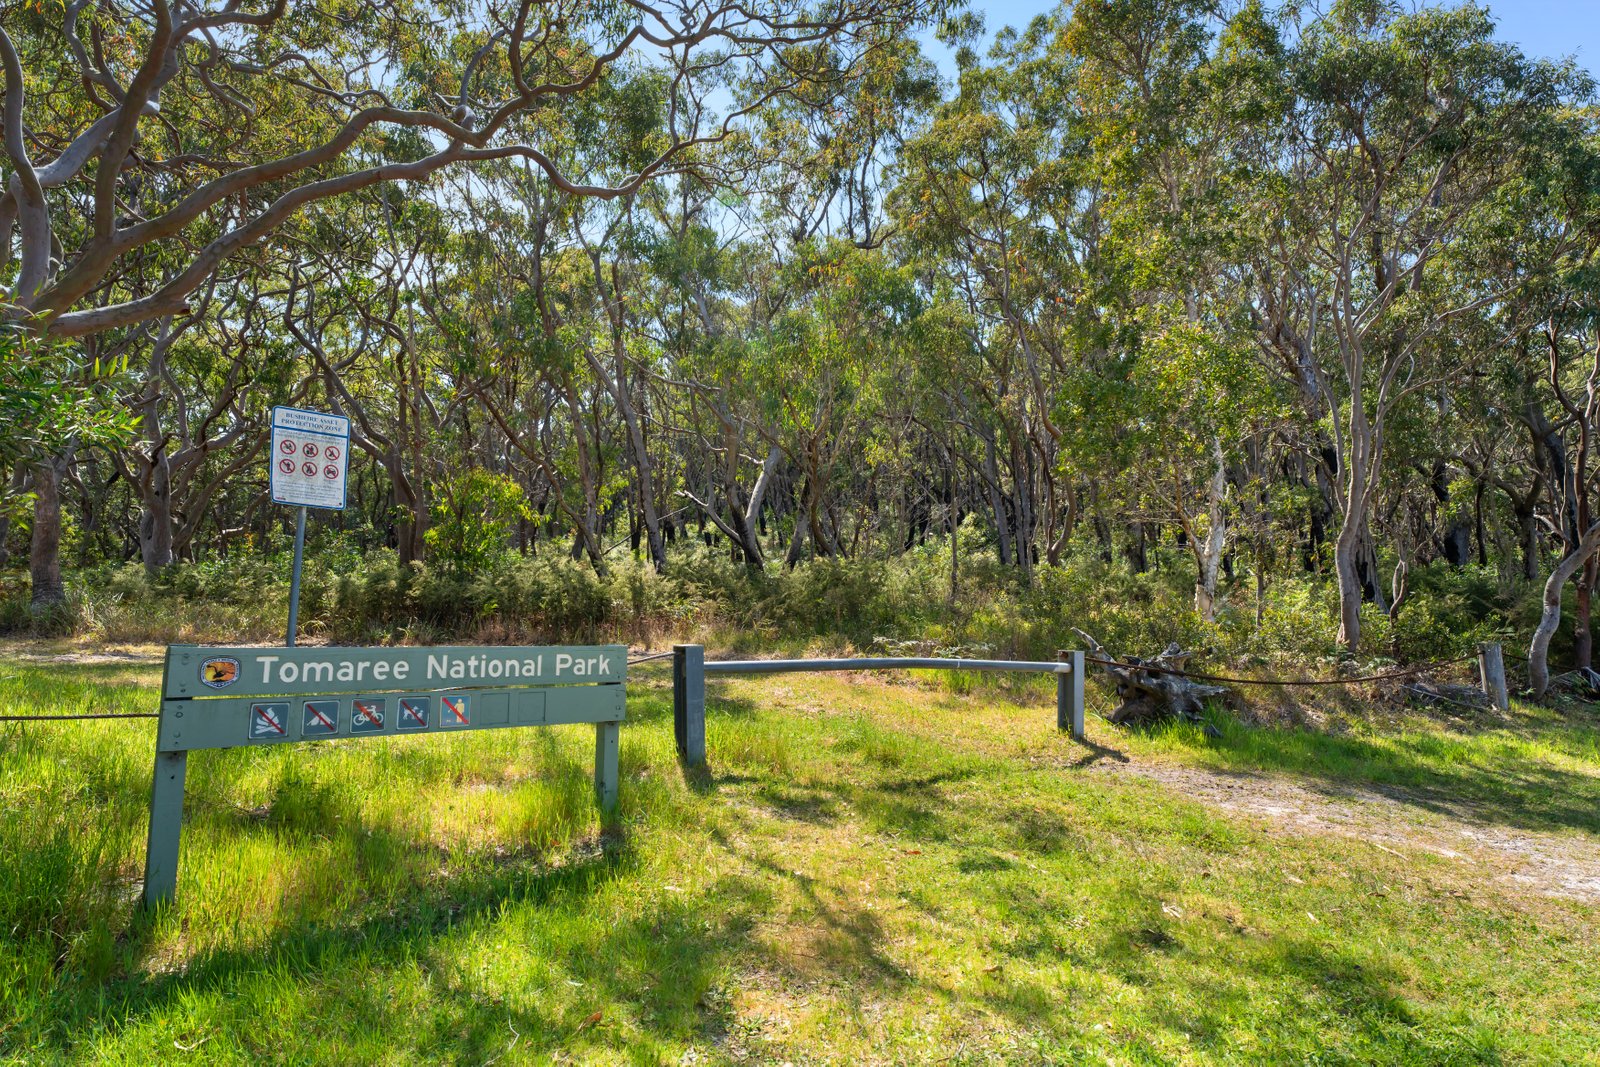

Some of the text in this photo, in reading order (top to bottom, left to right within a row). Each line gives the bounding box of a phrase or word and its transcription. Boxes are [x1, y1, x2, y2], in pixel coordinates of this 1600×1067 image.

[256, 655, 409, 683] Tomaree
[427, 654, 542, 679] National
[555, 653, 611, 676] Park
